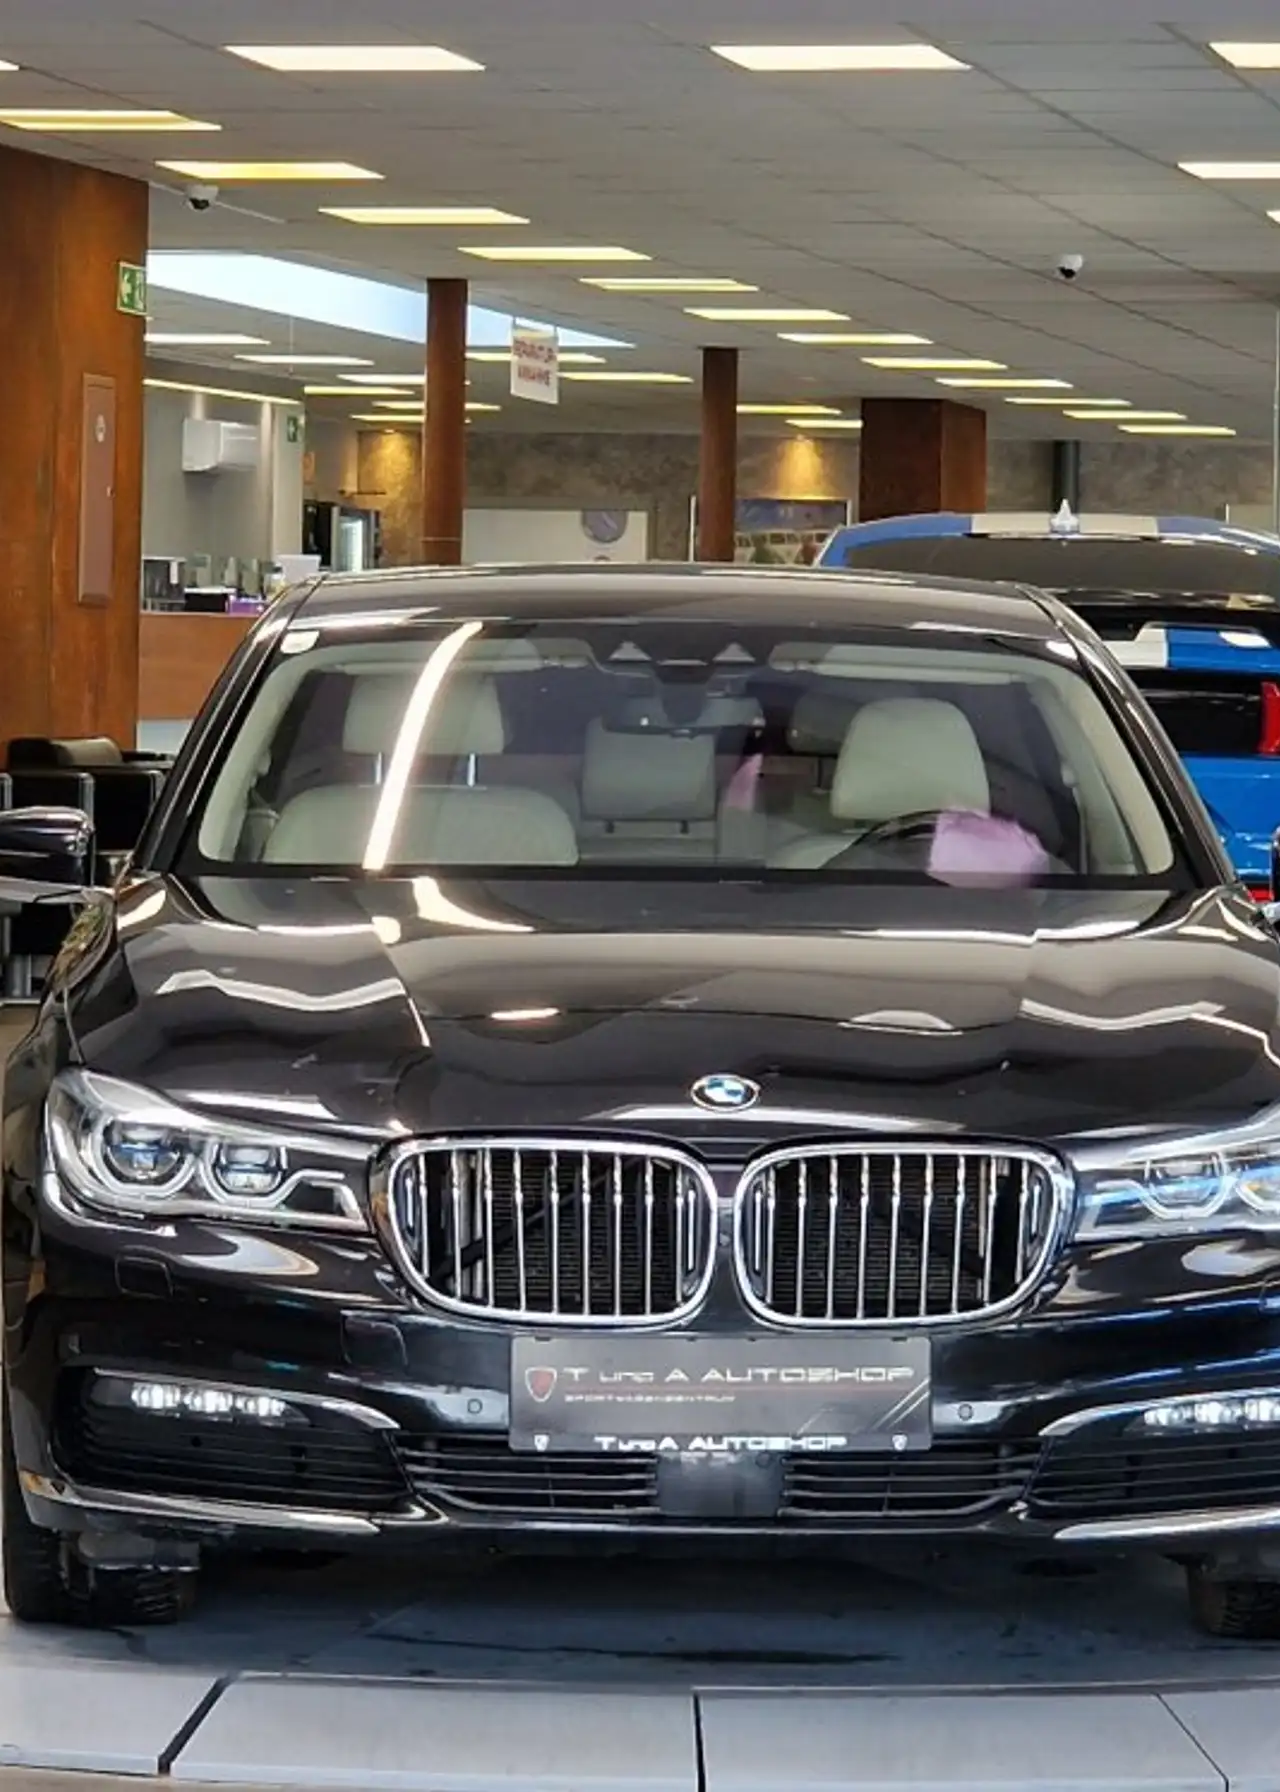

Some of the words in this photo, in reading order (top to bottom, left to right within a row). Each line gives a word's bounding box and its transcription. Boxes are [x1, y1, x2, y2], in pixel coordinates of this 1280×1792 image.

[563, 1367, 590, 1382] T
[664, 1368, 689, 1382] A
[701, 1367, 915, 1383] AUTOSHOP
[688, 1436, 848, 1451] AUTOSHOP
